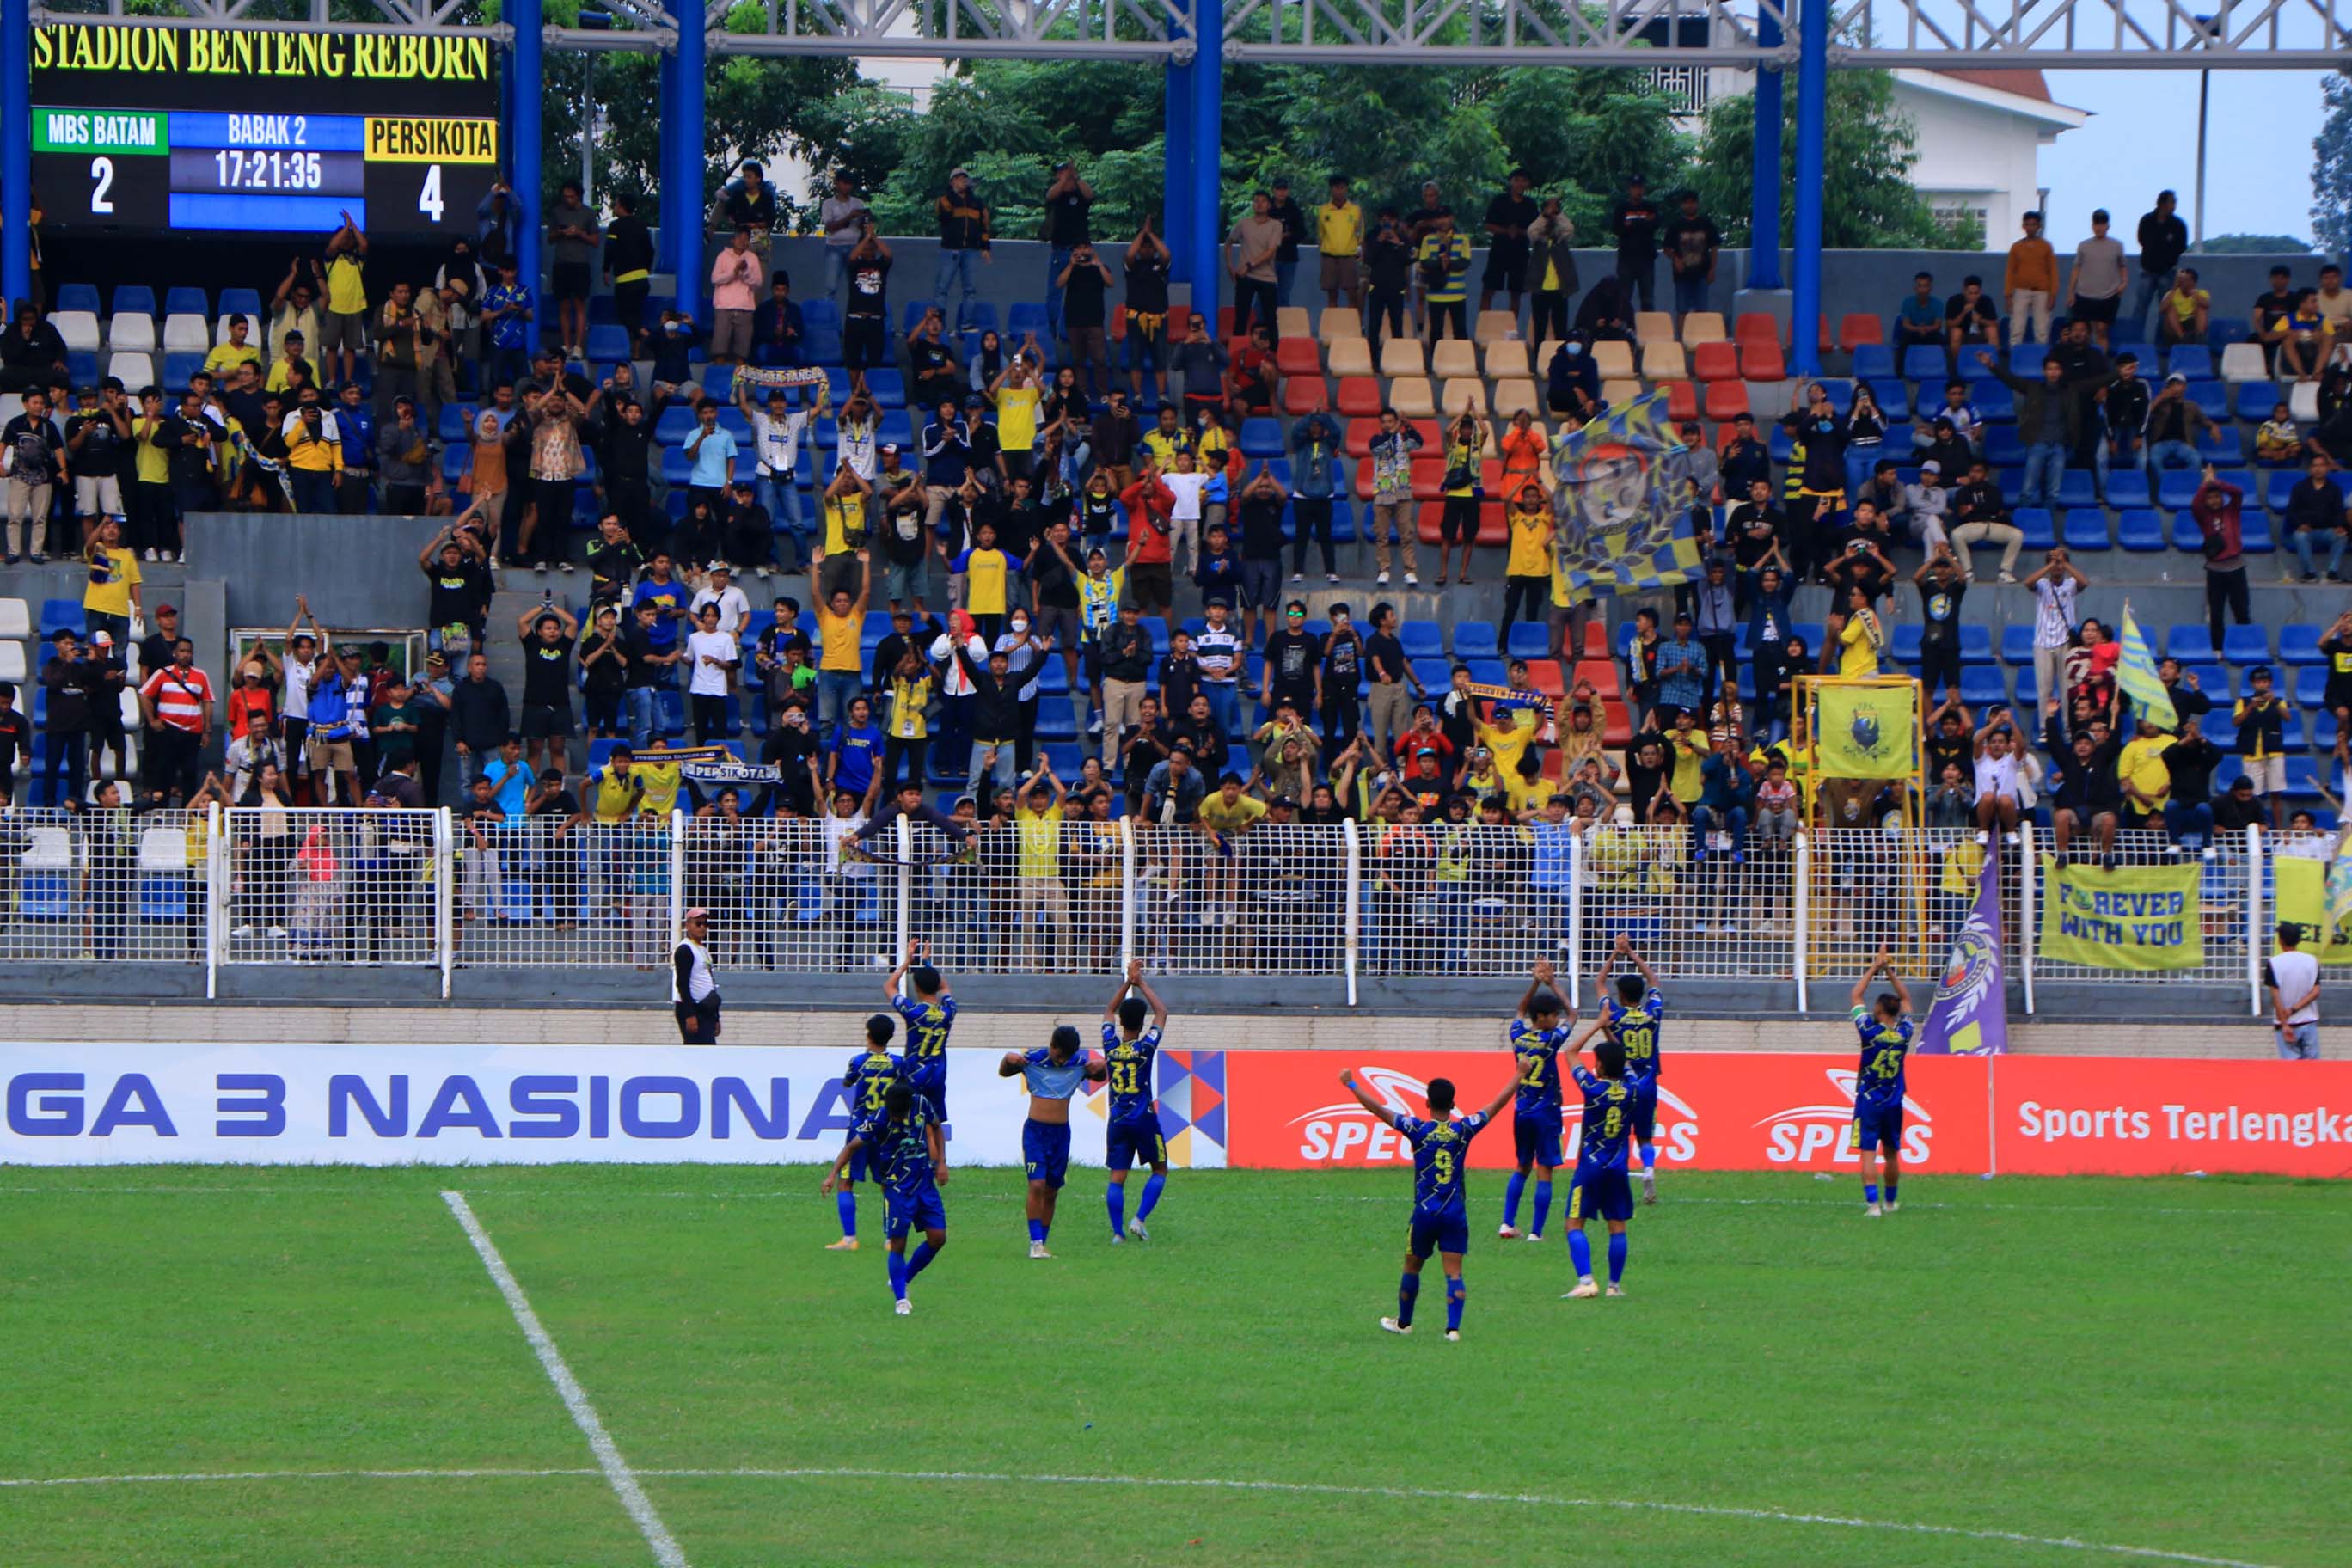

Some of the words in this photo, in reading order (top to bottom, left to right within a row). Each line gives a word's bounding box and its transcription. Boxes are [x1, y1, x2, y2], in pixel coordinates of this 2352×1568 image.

[34, 25, 178, 72] STADION
[187, 30, 345, 77] BENTENG
[352, 35, 488, 80] REBORN
[48, 113, 89, 144] MBS
[94, 116, 156, 146] BATAM
[229, 114, 289, 145] BABAK
[294, 116, 306, 144] 2
[371, 119, 493, 157] PERSIKOTA
[91, 157, 113, 213] 2
[215, 150, 322, 188] 17:21:35
[419, 165, 444, 221] 4
[695, 766, 767, 780] PERSIKOTA
[2061, 911, 2123, 946] WITH
[2131, 921, 2184, 946] YOU
[1622, 1028, 1652, 1059] 90
[1110, 1061, 1139, 1093] 31
[1871, 1049, 1902, 1079] 45
[216, 1074, 286, 1136] 3
[328, 1075, 952, 1141] NASIONA
[1604, 1106, 1623, 1138] 8
[2019, 1101, 2151, 1142] Sports
[1767, 1123, 1933, 1164] SPES
[1435, 1148, 1452, 1184] 9
